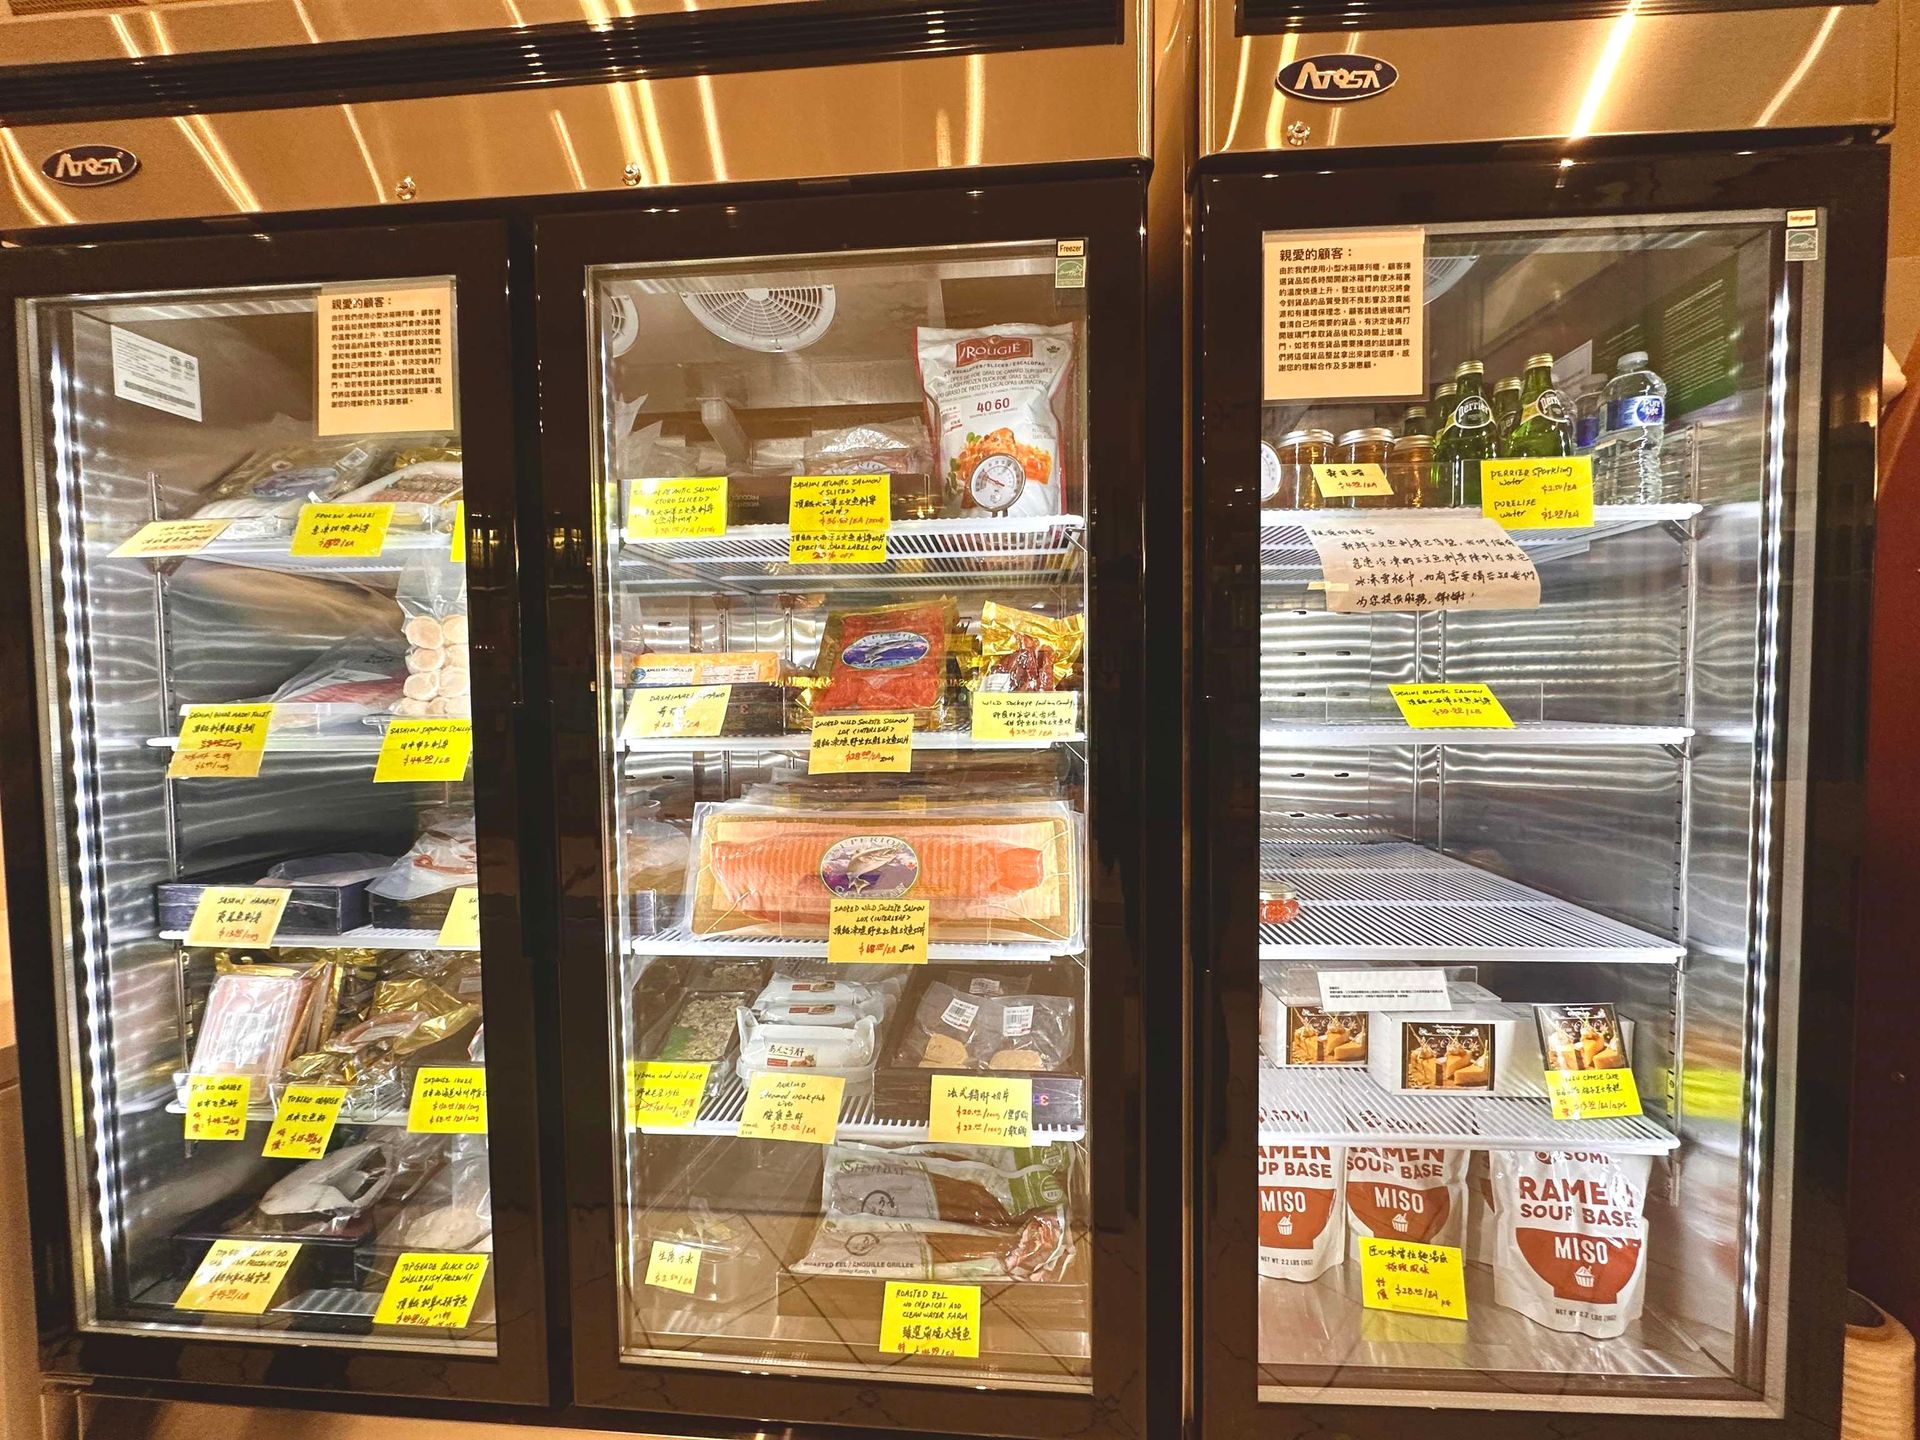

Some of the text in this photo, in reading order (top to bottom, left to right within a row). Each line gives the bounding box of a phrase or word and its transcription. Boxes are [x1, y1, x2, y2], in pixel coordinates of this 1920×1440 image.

[1280, 247, 1352, 261] 親愛的顧客：
[332, 297, 392, 310] 親愛的顧客：
[977, 397, 1010, 412] 40 60
[852, 477, 881, 486] SALMON
[693, 485, 720, 494] SALMON
[767, 1044, 804, 1056] あんこう肝
[1258, 1145, 1331, 1161] AMEN
[1286, 1163, 1333, 1179] BASE
[1347, 1156, 1443, 1180] SOUP BASE
[1261, 1190, 1307, 1213] MISO
[1374, 1187, 1424, 1213] MISO
[1555, 1236, 1608, 1264] MISO
[440, 1262, 463, 1271] BLACK
[465, 1262, 479, 1271] COD
[896, 1289, 948, 1299] ROASTED EEL
